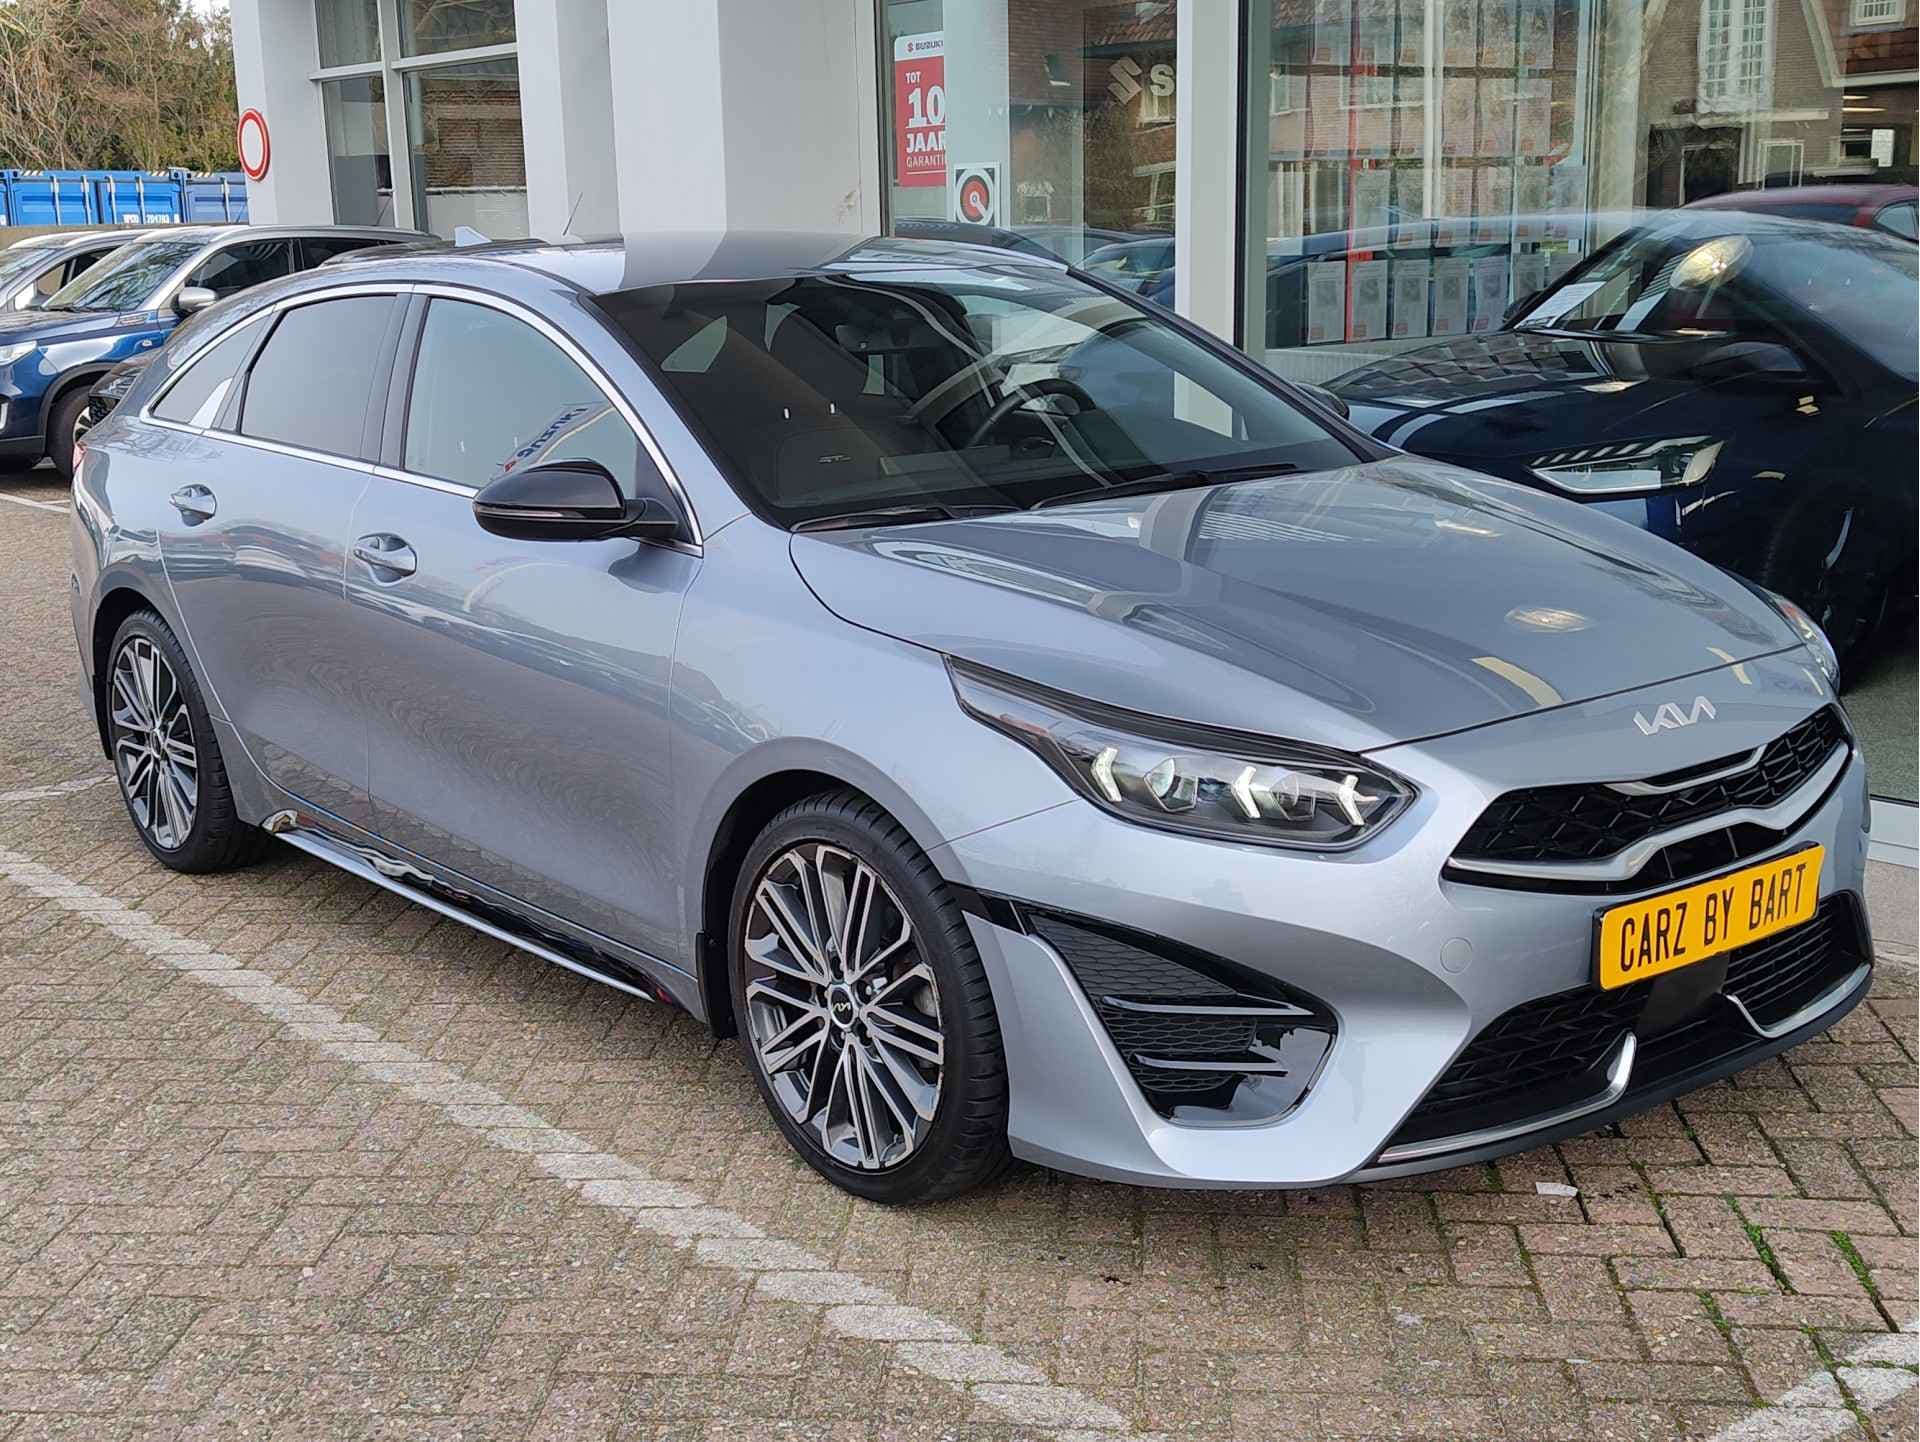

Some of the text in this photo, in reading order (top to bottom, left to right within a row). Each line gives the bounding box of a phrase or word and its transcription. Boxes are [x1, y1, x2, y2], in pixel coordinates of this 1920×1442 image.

[915, 40, 944, 51] SUZUKI
[905, 71, 921, 84] TOT
[908, 85, 945, 128] 10
[1632, 695, 1717, 736] KIA
[1619, 863, 1808, 973] CARZ BY BART
